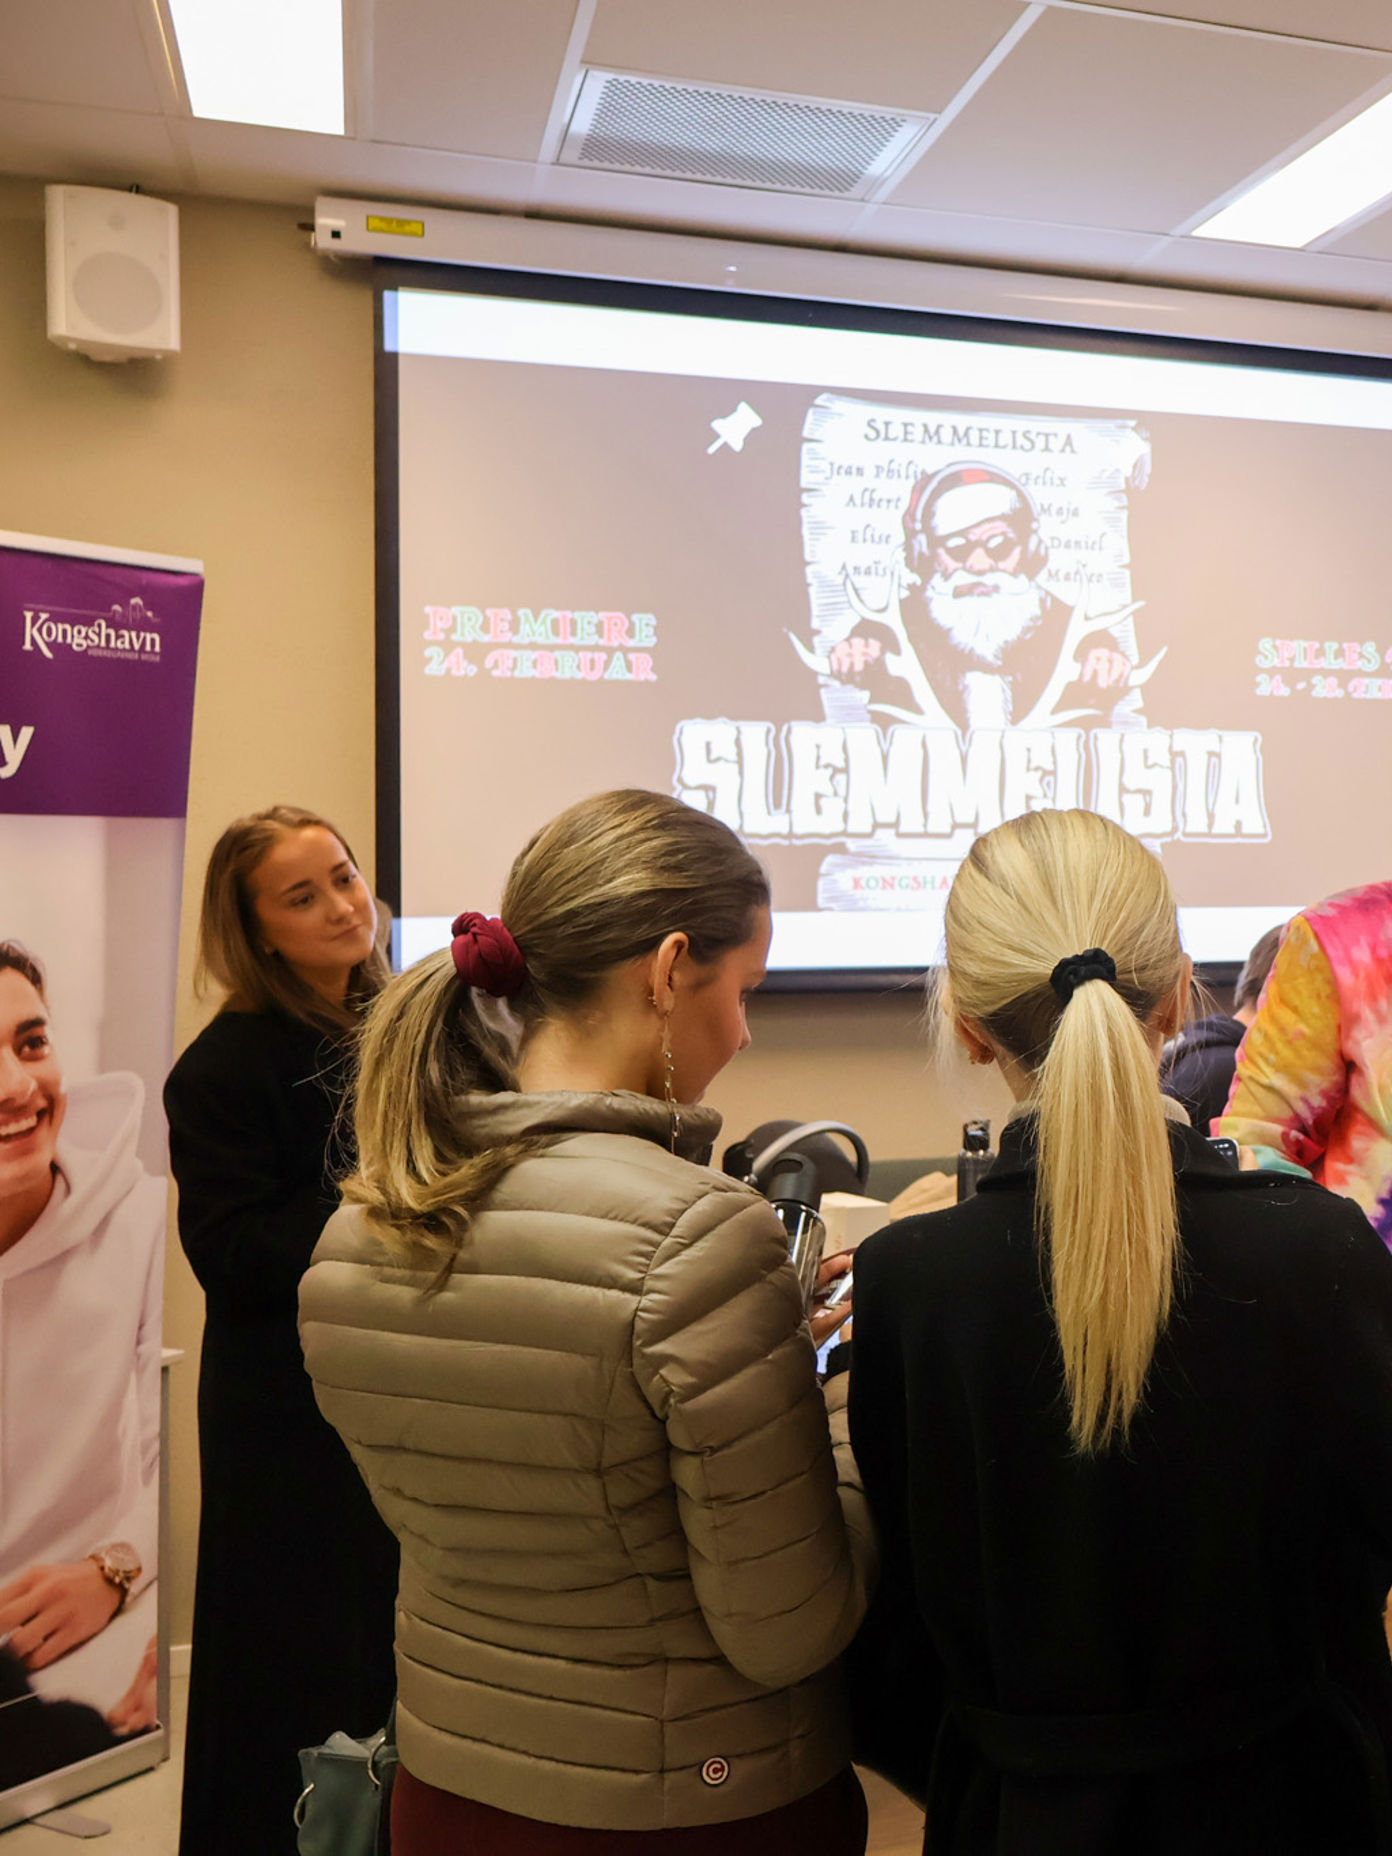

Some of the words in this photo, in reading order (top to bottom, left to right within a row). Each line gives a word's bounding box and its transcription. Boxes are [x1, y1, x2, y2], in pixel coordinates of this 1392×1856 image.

[863, 418, 1077, 455] SLEMMELISTA
[825, 461, 864, 480] Jean
[1018, 466, 1067, 487] Felix
[845, 487, 901, 510] Albert
[1039, 502, 1080, 524] Maja
[850, 524, 892, 544] Elise
[1048, 532, 1107, 551] Daniel
[22, 609, 161, 659] Kongshavn
[423, 604, 658, 648] PREMIERE
[424, 645, 478, 677] 24.
[484, 647, 658, 681] FEBRUAR
[1255, 637, 1381, 672] SPILLES
[672, 717, 1272, 843] SLEMMELISTA
